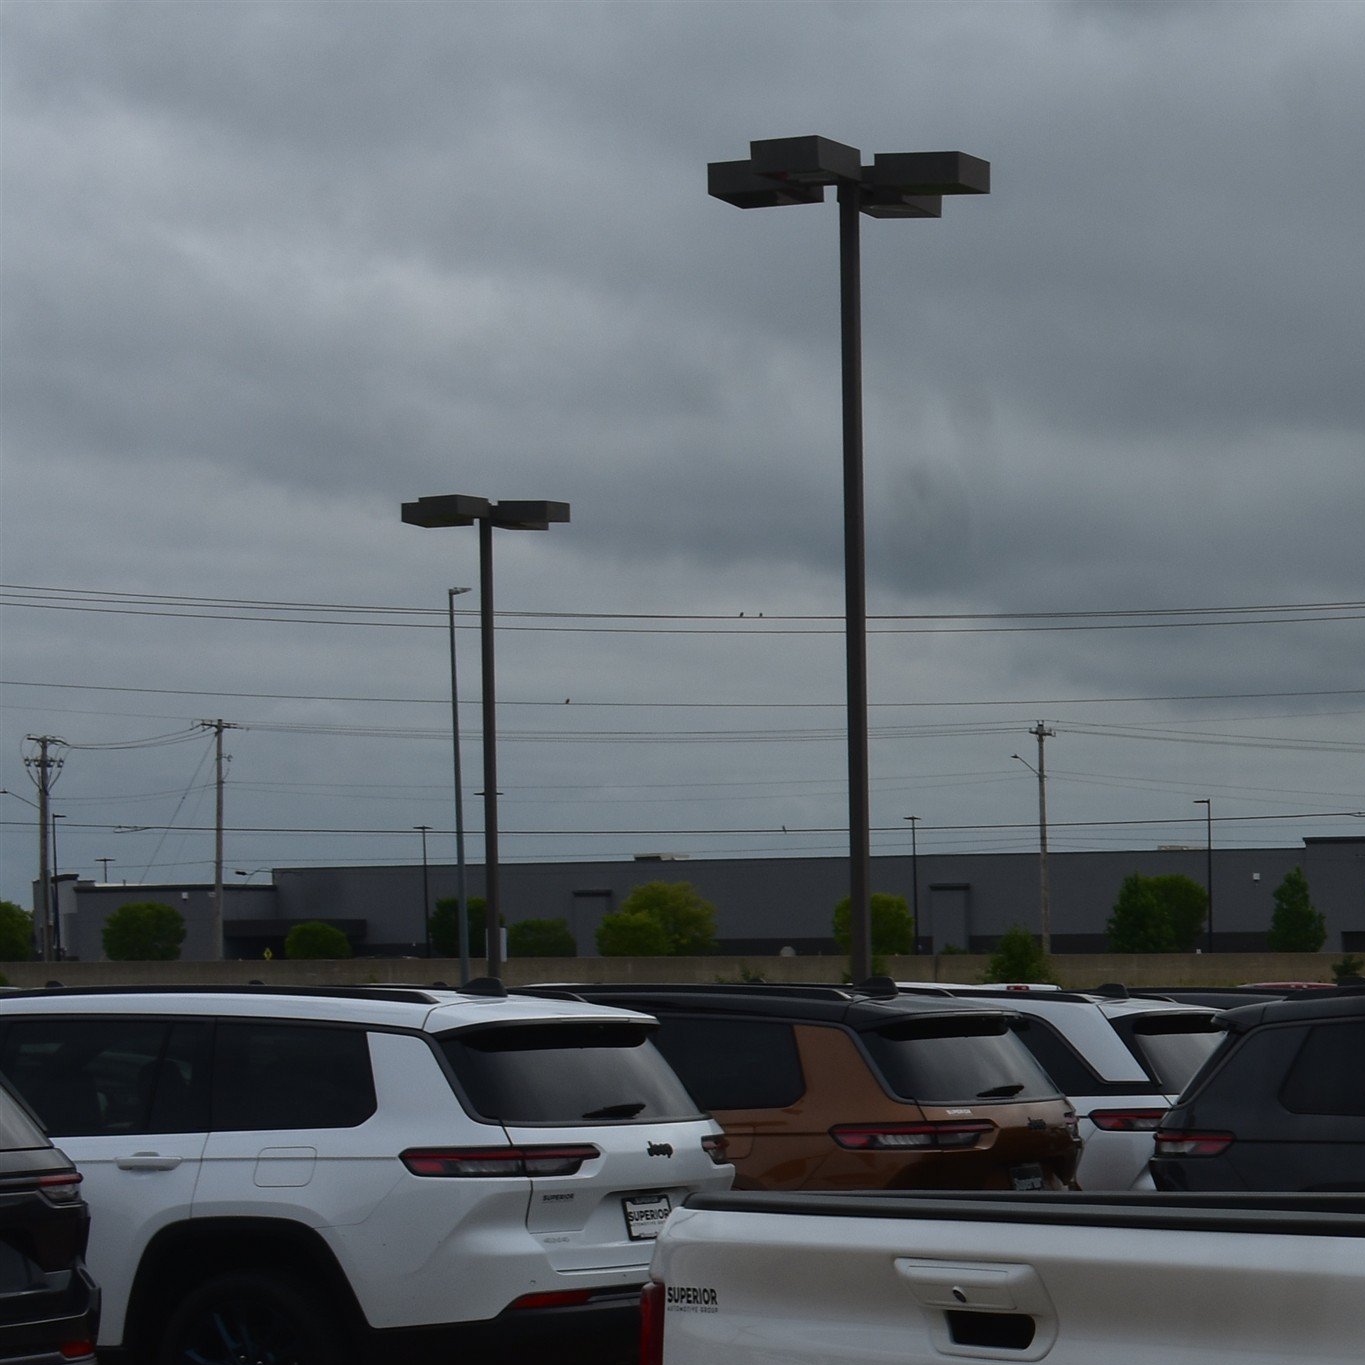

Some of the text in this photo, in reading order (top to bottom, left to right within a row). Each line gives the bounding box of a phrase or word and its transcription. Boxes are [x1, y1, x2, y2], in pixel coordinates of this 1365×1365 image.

[647, 1141, 673, 1158] Jeep
[628, 1208, 669, 1222] SUPERIOR
[667, 1287, 718, 1305] SUPERIOR
